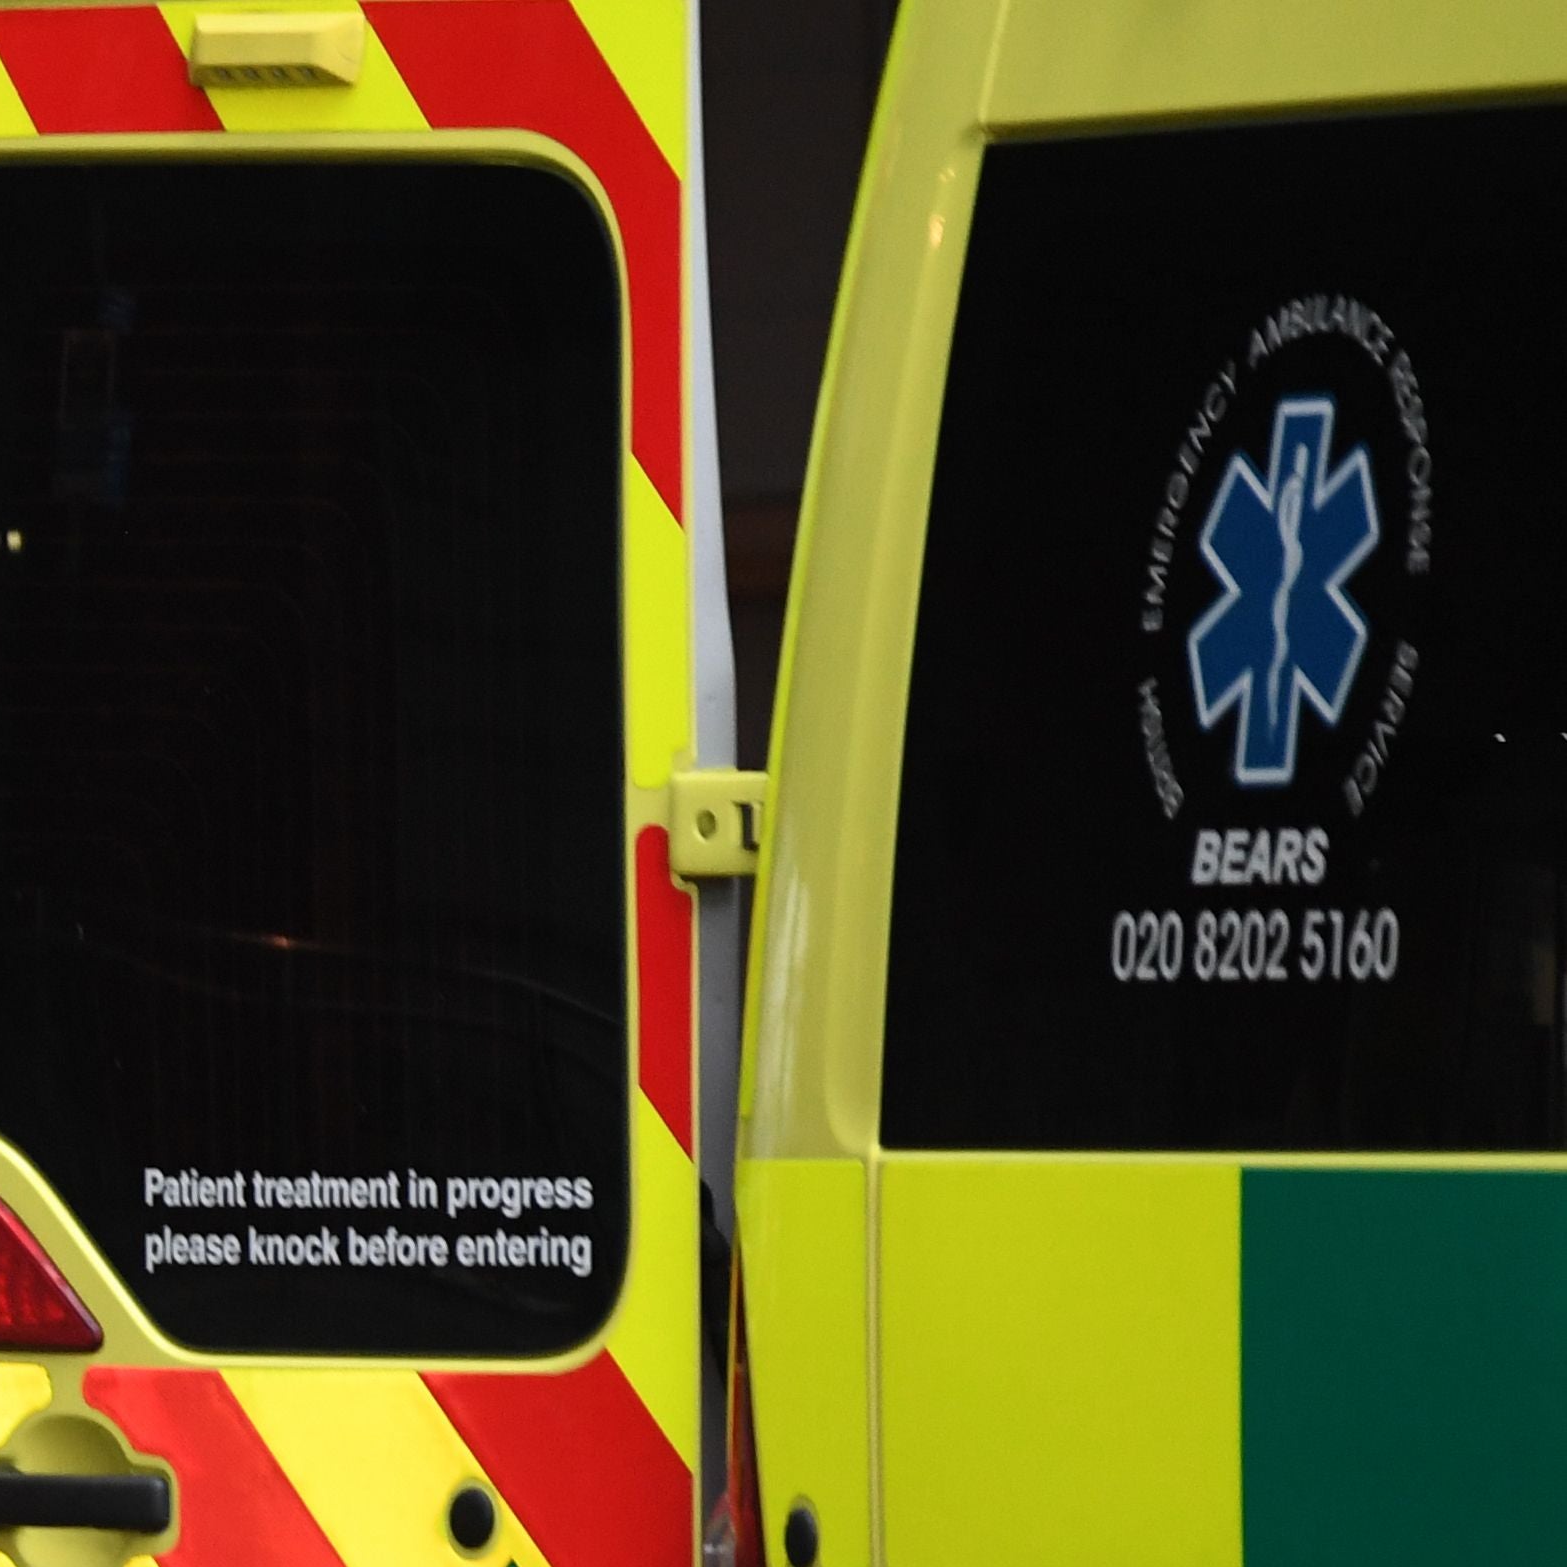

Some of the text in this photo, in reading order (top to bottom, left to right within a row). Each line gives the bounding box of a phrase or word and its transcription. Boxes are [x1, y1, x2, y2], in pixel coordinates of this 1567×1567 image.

[1190, 827, 1330, 885] BEARS
[1111, 907, 1400, 981] 020 8202 5160
[144, 1167, 594, 1219] Patient treatment in progress
[144, 1224, 593, 1277] please knock before entering
